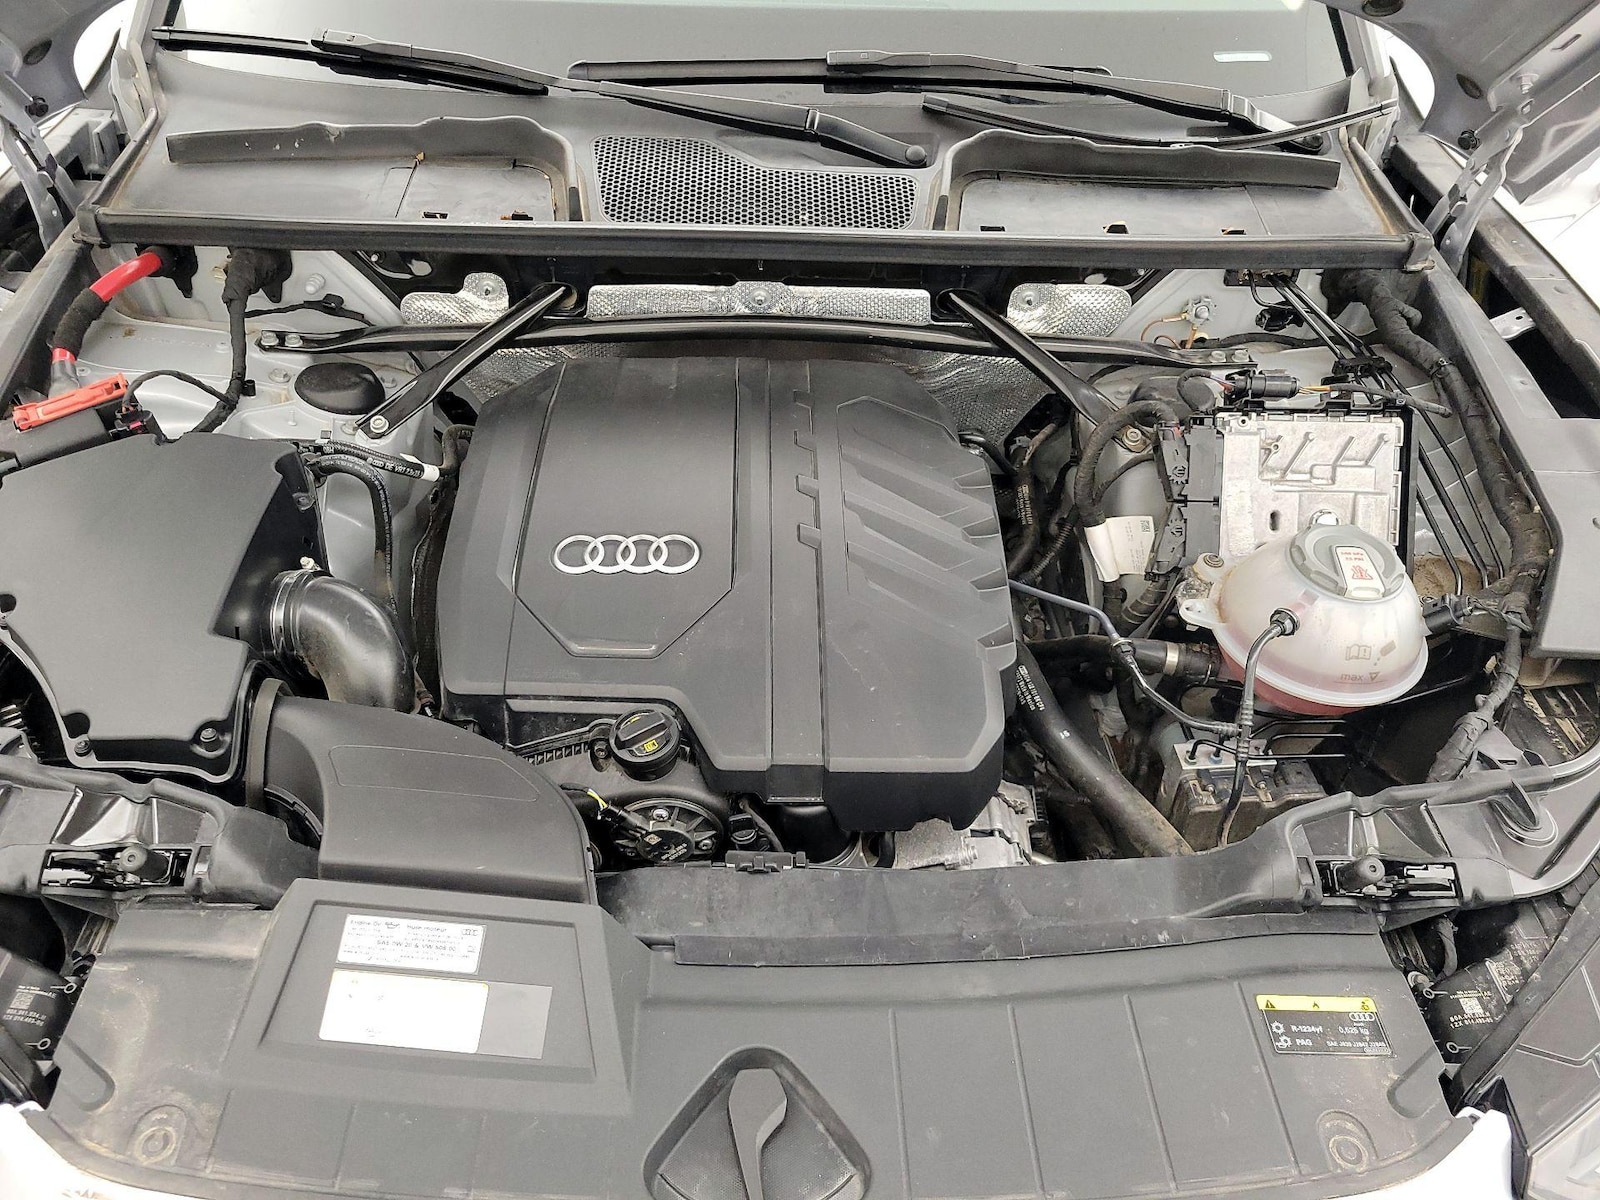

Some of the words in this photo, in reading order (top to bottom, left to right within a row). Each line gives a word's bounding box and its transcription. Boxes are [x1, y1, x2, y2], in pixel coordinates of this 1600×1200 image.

[1340, 673, 1364, 682] max
[1290, 1024, 1323, 1034] R-1234yf
[1359, 1027, 1370, 1035] kg
[1295, 1038, 1313, 1046] PAG
